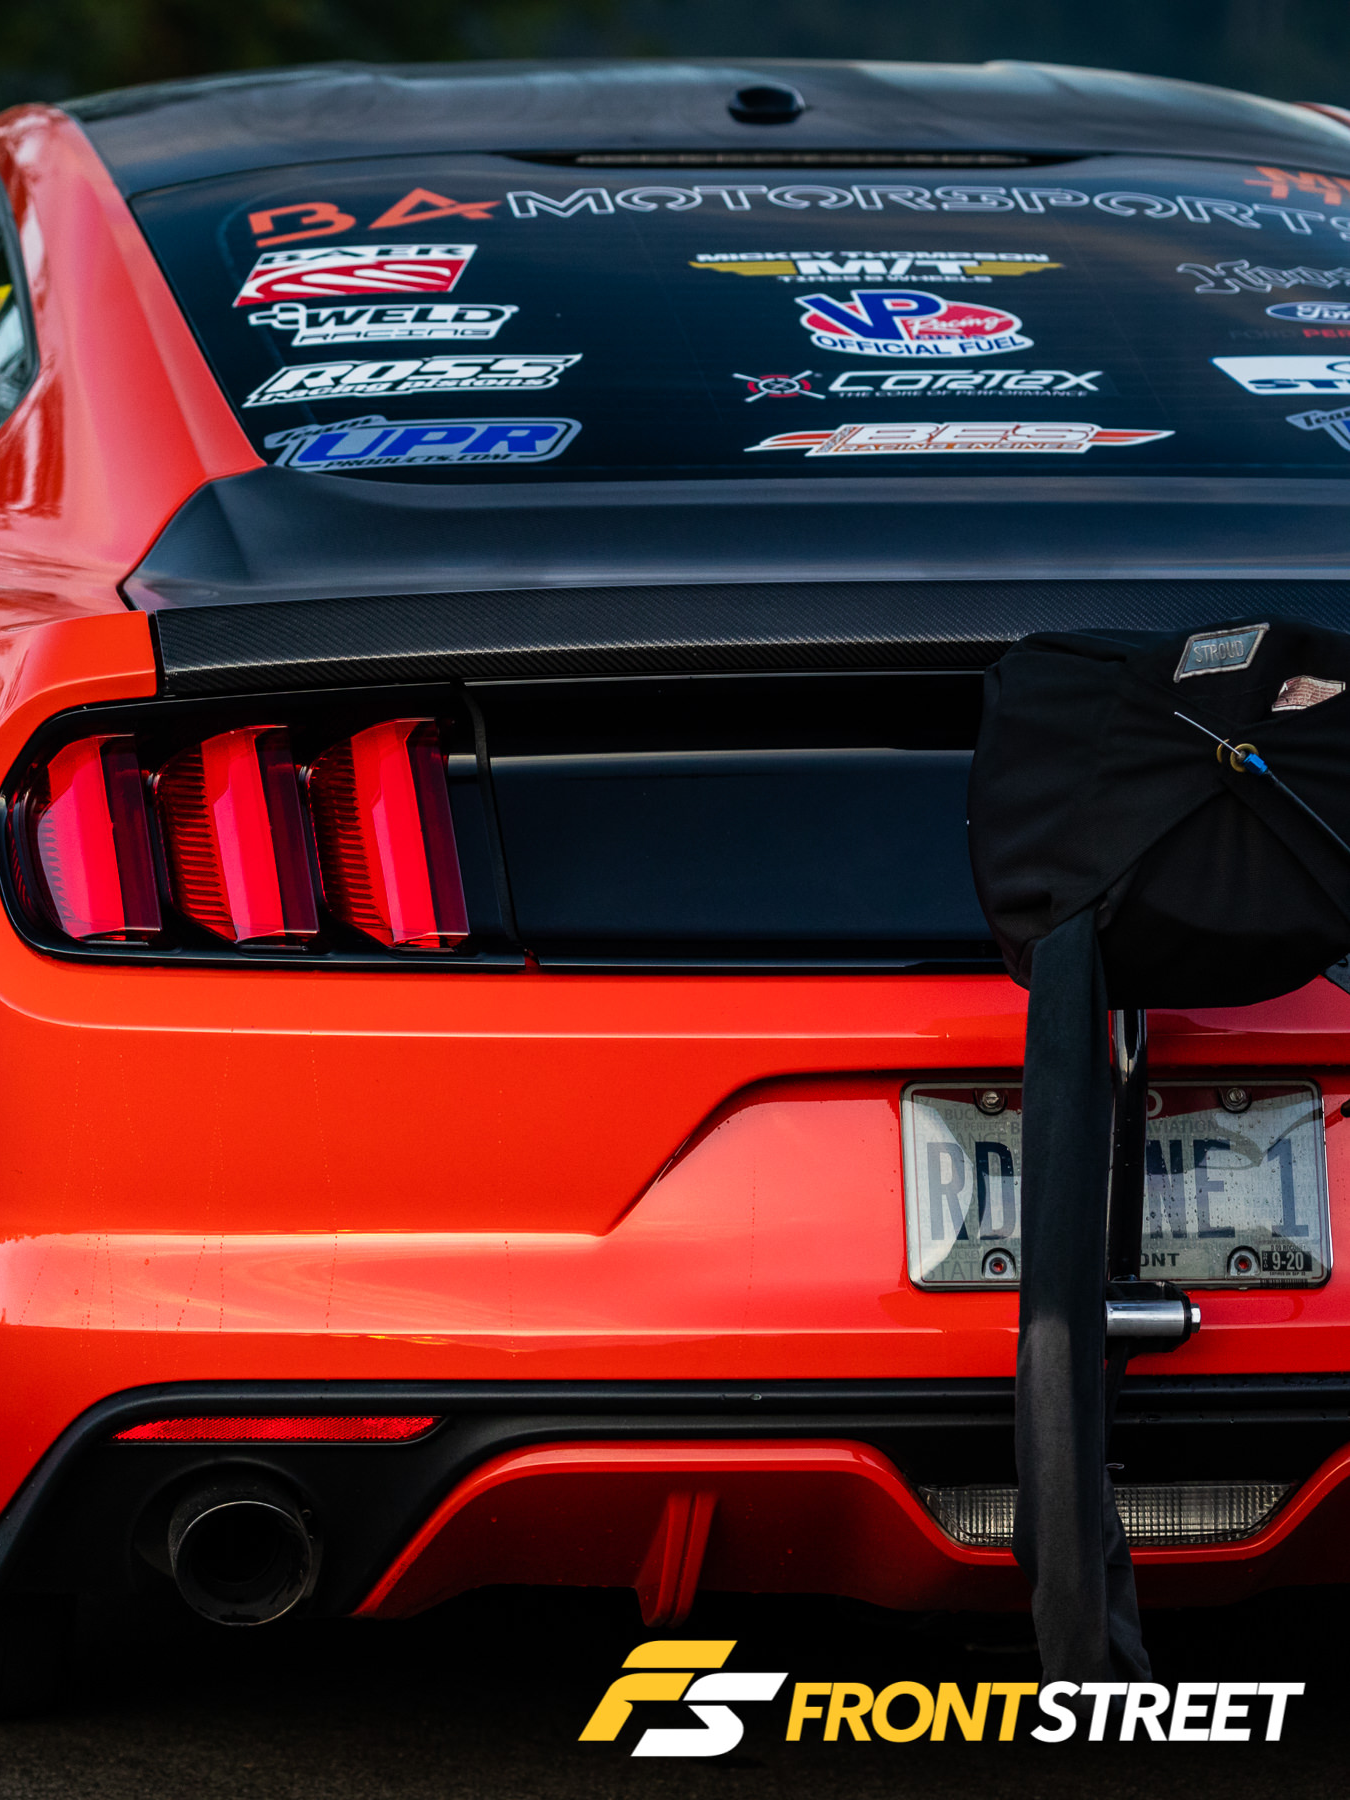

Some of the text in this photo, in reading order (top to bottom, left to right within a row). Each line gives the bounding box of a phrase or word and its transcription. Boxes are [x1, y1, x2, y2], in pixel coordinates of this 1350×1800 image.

[506, 184, 1350, 242] MOTORSPORT
[697, 251, 1050, 262] MICKEY THOMPSON
[796, 258, 978, 275] M/T
[886, 275, 992, 283] WHEELS
[306, 306, 505, 328] WELD
[799, 291, 943, 341] VP
[907, 316, 1008, 335] Racing
[300, 328, 492, 342] RACING
[816, 335, 1026, 355] OFFICIAL FUEL
[265, 358, 564, 392] ROSS
[260, 377, 548, 402] racing pistons
[837, 390, 1088, 398] THE CORE OF PERFORMANCE
[847, 422, 1094, 444] BES
[298, 426, 559, 462] UPR
[1193, 640, 1245, 663] STROUD
[1272, 1251, 1304, 1270] 9-20
